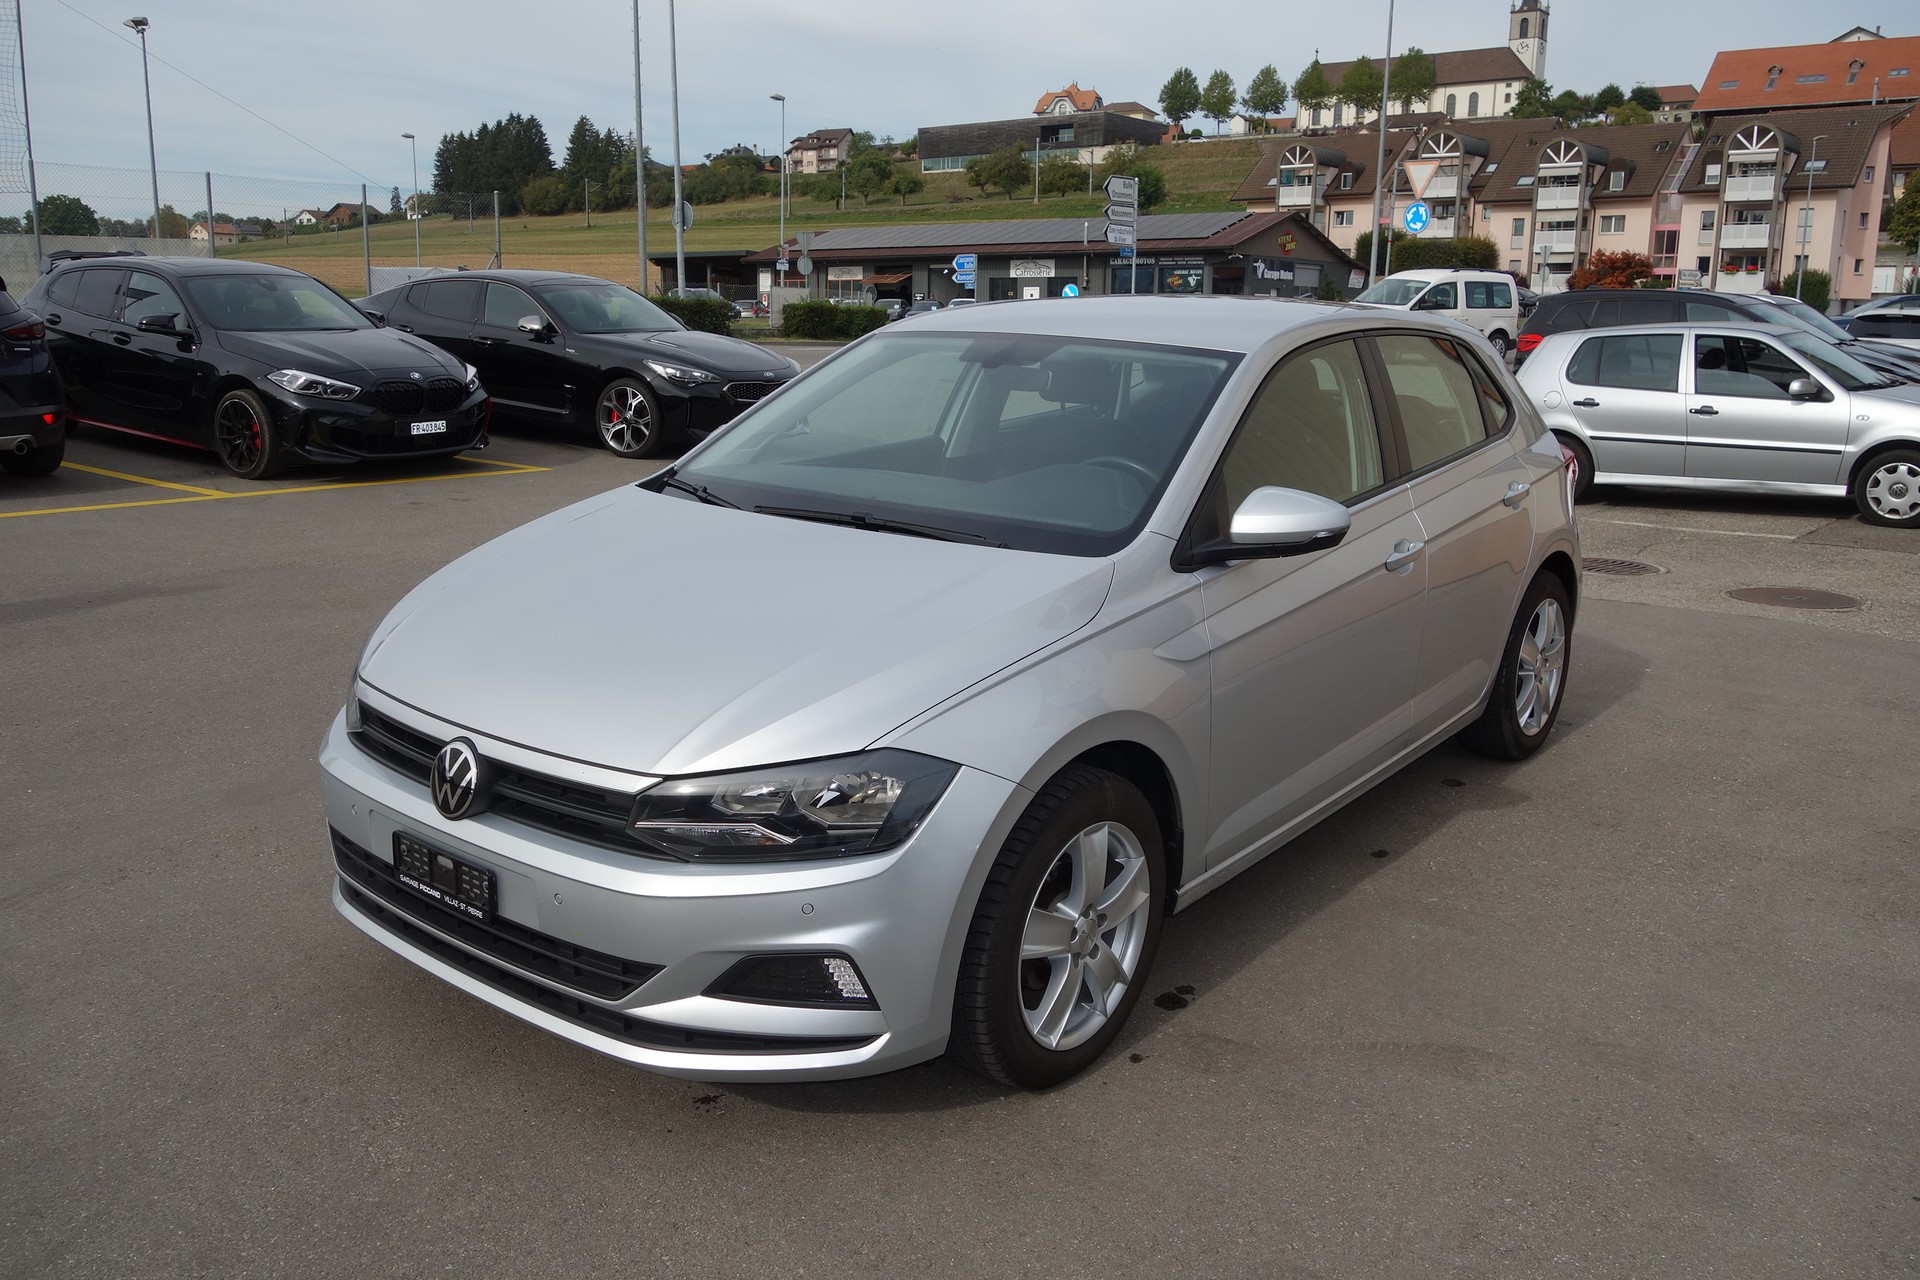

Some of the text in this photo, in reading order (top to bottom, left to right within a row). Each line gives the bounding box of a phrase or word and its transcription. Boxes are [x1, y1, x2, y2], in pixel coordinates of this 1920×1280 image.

[1123, 181, 1132, 189] Bulle
[1015, 268, 1051, 276] Carrosserie
[1264, 269, 1293, 280] Garage Motos
[400, 874, 419, 889] GARAGE
